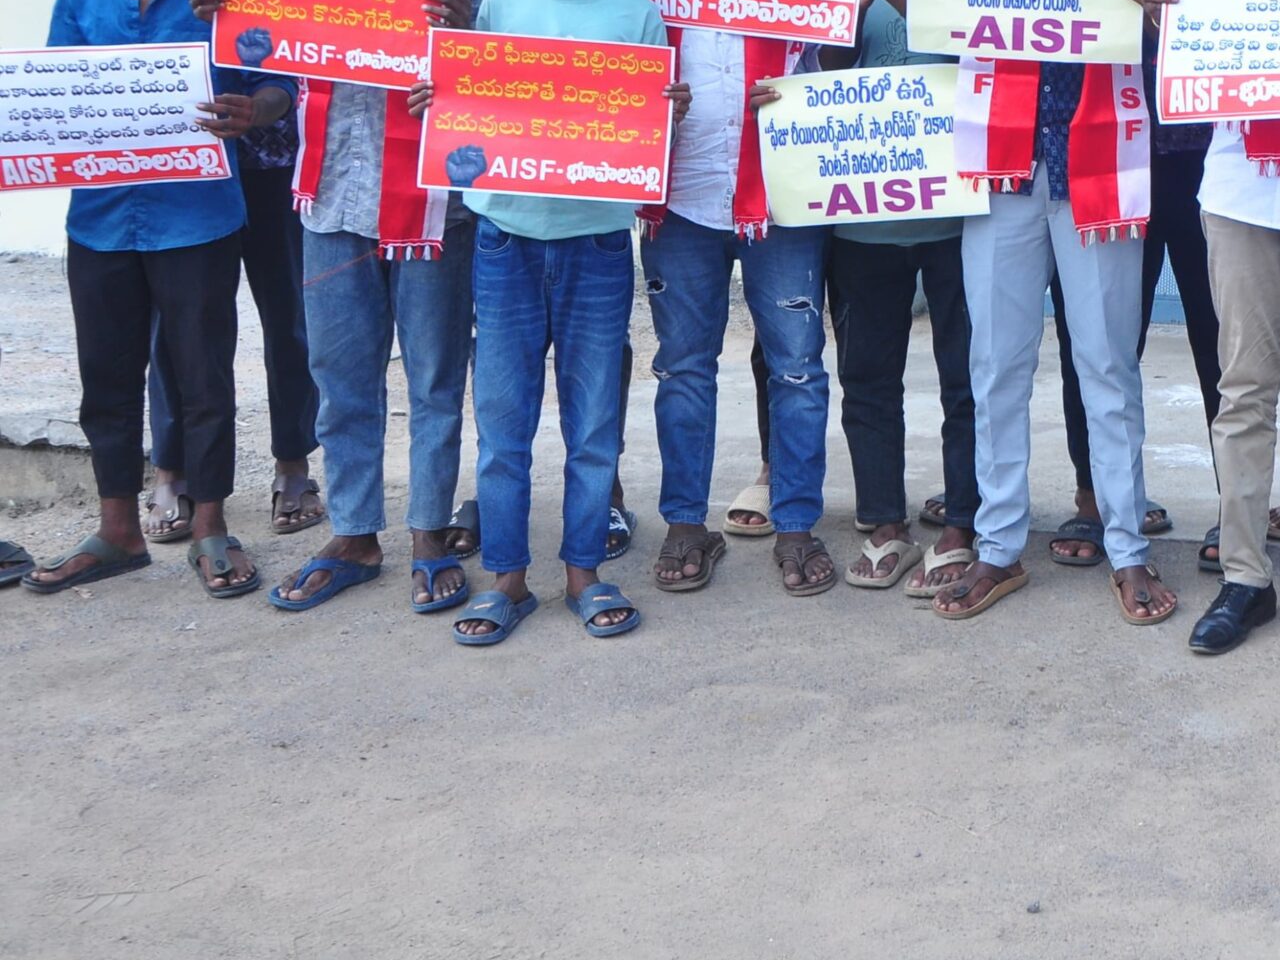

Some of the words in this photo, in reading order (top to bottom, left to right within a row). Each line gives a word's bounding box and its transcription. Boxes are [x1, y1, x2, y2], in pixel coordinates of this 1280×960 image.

[504, 42, 565, 65] ఫీజులు
[572, 50, 664, 75] చెల్లింపులు
[71, 82, 125, 96] విడుదల
[130, 79, 189, 94] చేయండి
[896, 76, 934, 107] ఉన్న
[1170, 77, 1224, 112] AISF
[69, 105, 107, 119] కోసం
[434, 112, 524, 137] చదువులు
[3, 157, 56, 185] AISF
